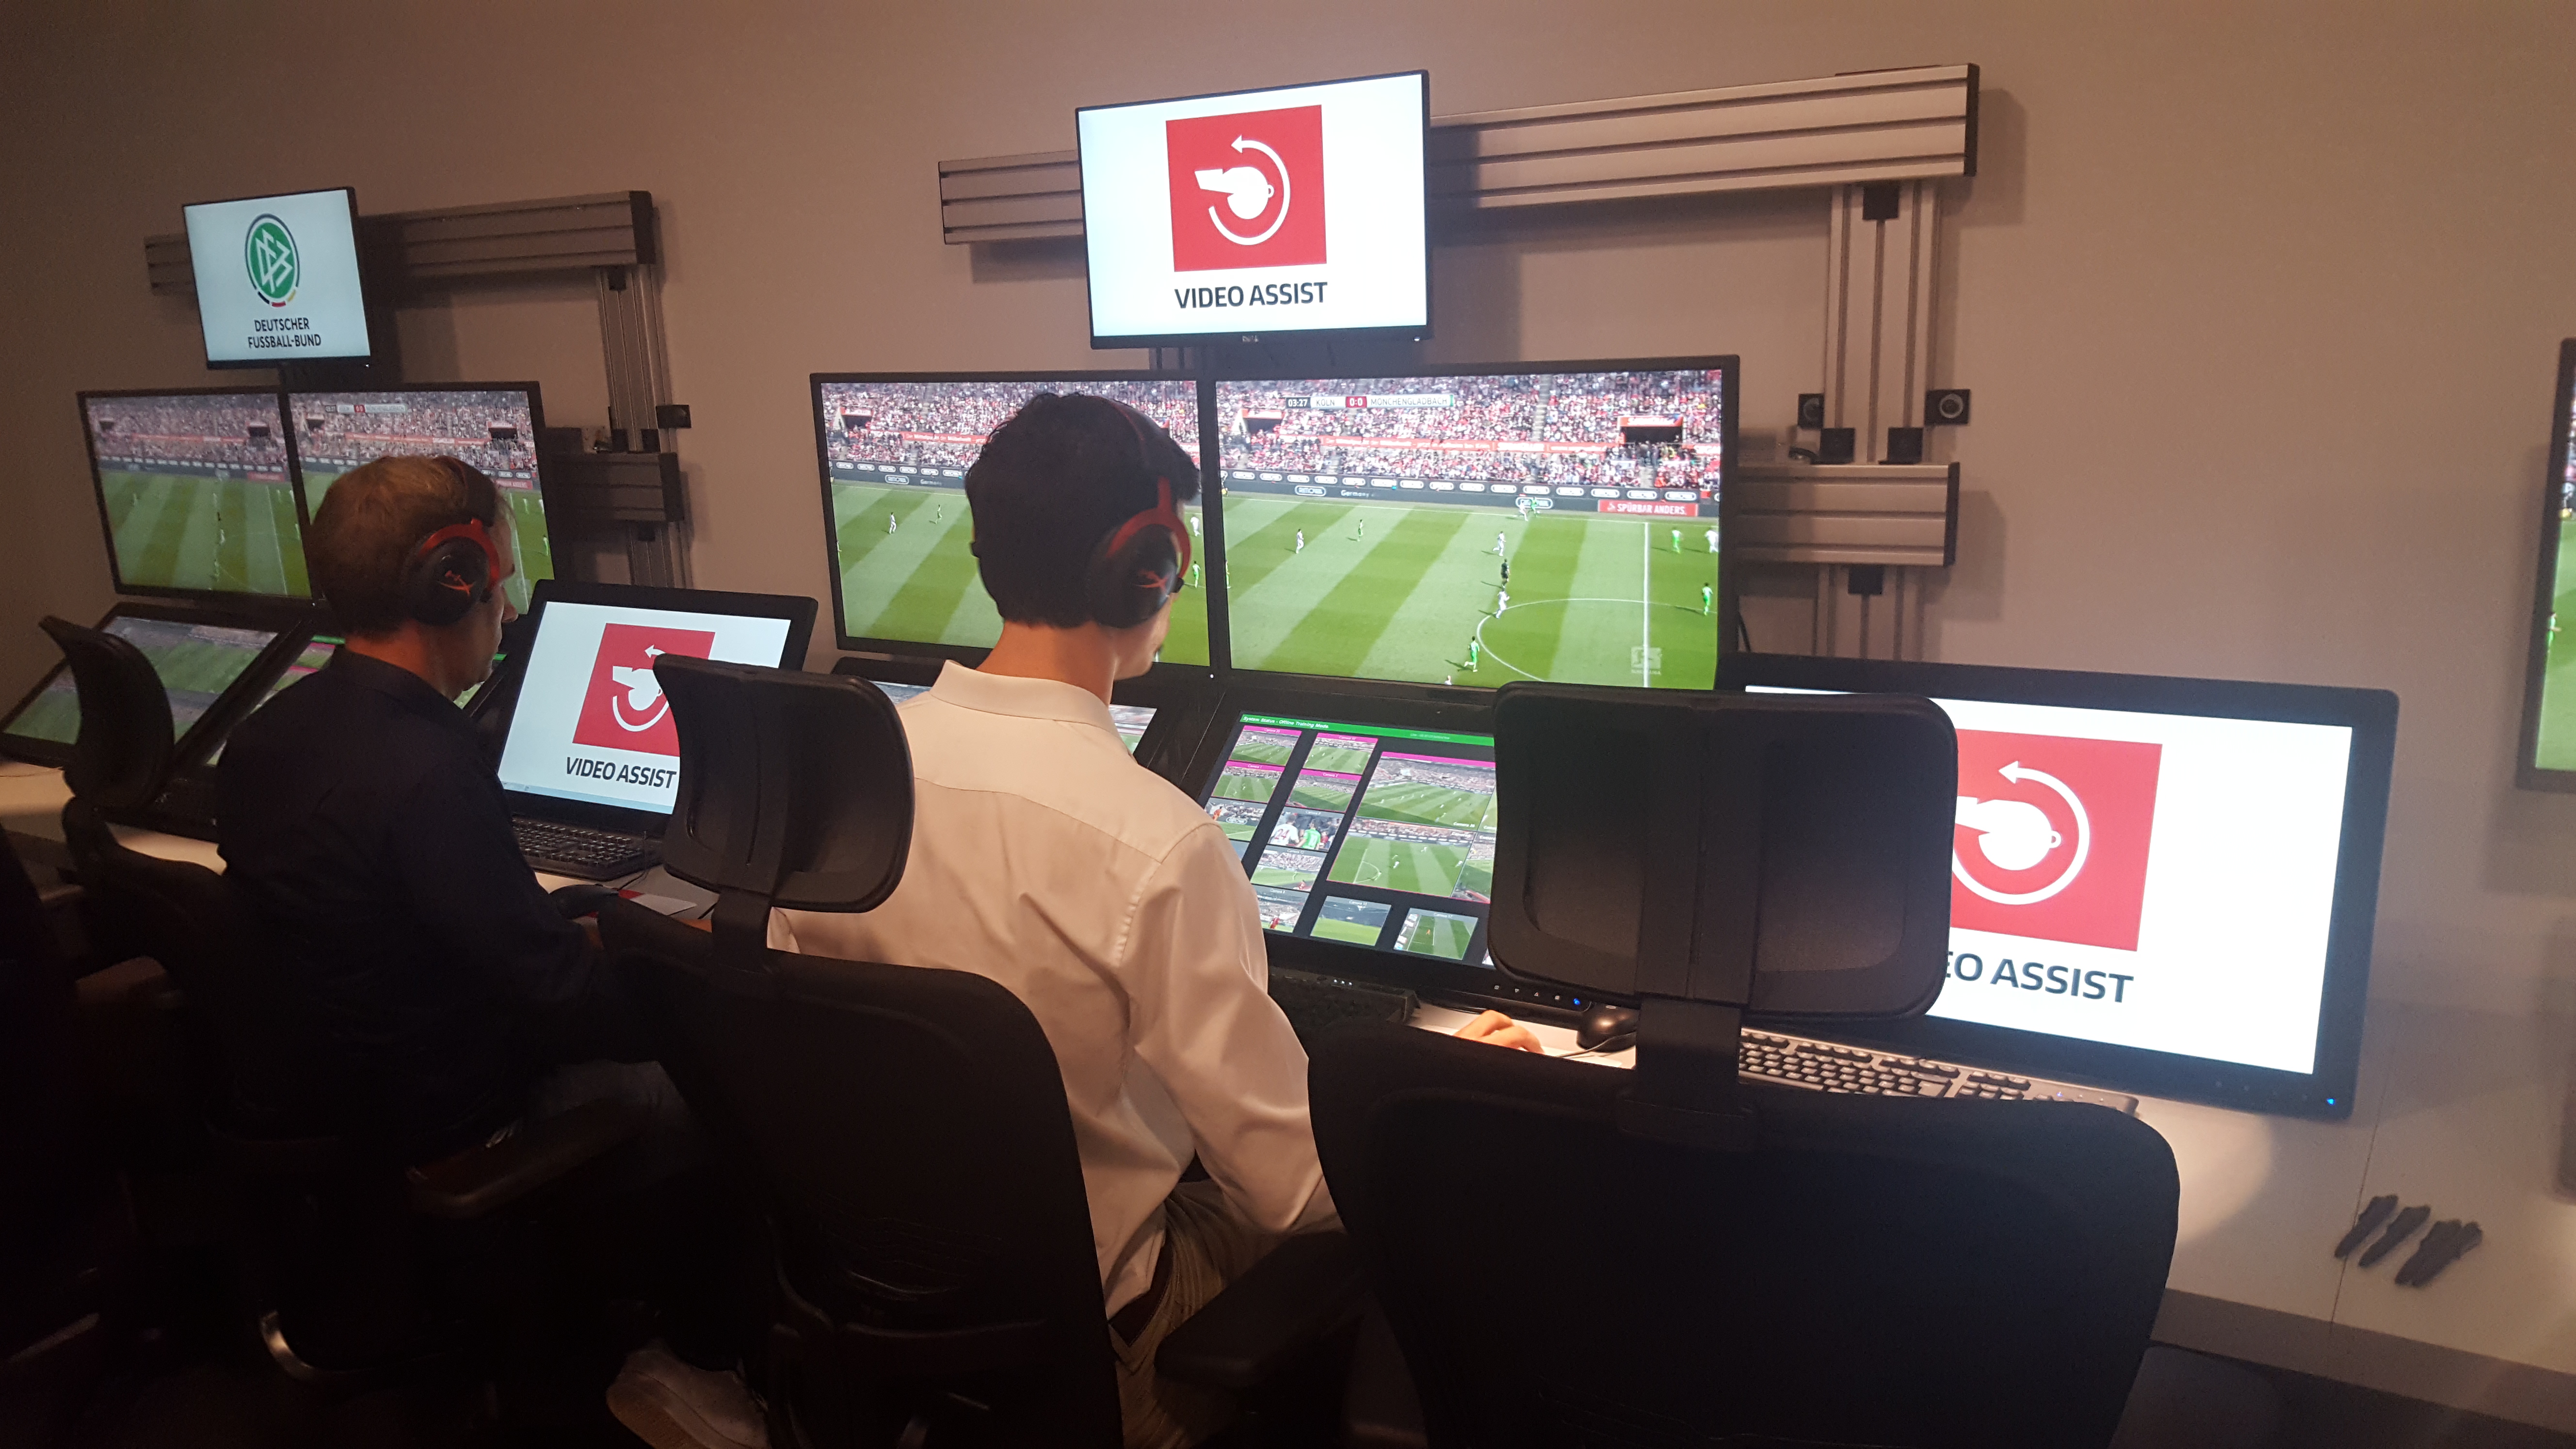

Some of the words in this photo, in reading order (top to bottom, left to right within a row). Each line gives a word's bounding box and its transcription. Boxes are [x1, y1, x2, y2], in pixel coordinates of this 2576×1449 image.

[1174, 285, 1244, 308] VIDEO
[1249, 281, 1328, 306] ASSIST
[254, 317, 310, 332] DEUTSCHER
[248, 334, 322, 349] FUSSBALL-BUND
[1288, 399, 1308, 407] 03:27
[1349, 398, 1363, 406] 0:0
[1340, 489, 1370, 498] Germany
[566, 757, 616, 780] VIDEO
[616, 764, 677, 789] ASSIST
[1274, 828, 1289, 840] 24
[1990, 958, 2134, 1003] ASSIST
